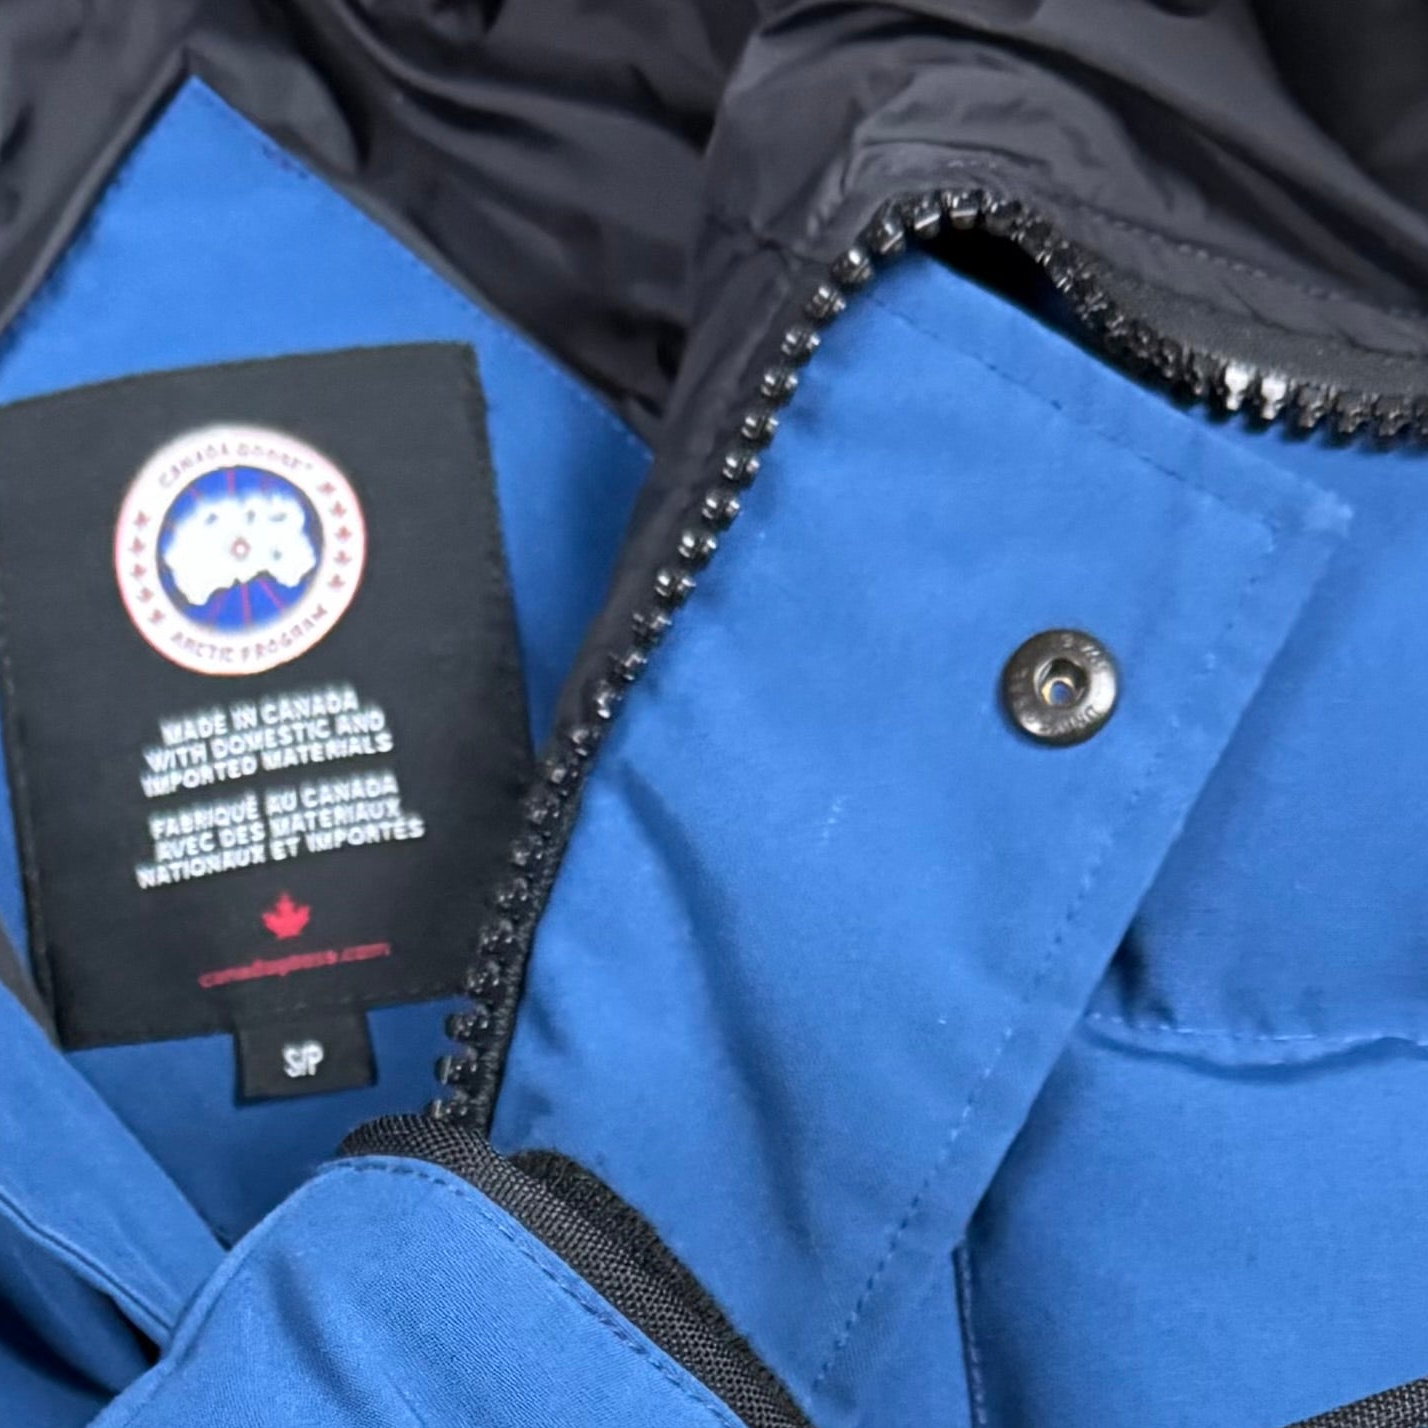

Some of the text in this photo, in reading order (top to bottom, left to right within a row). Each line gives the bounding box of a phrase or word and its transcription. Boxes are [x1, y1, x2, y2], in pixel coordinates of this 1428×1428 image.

[143, 705, 386, 773] WITH DOMESTIC AND
[160, 685, 360, 746] MADE IN CANADA
[140, 731, 394, 798] IMPORTED MATERIALS
[265, 788, 298, 816] AU
[299, 773, 399, 808] CANADA
[135, 844, 267, 889] NATIONAUX
[269, 836, 301, 861] ET
[155, 832, 215, 863] AVEC
[217, 821, 266, 848] DES
